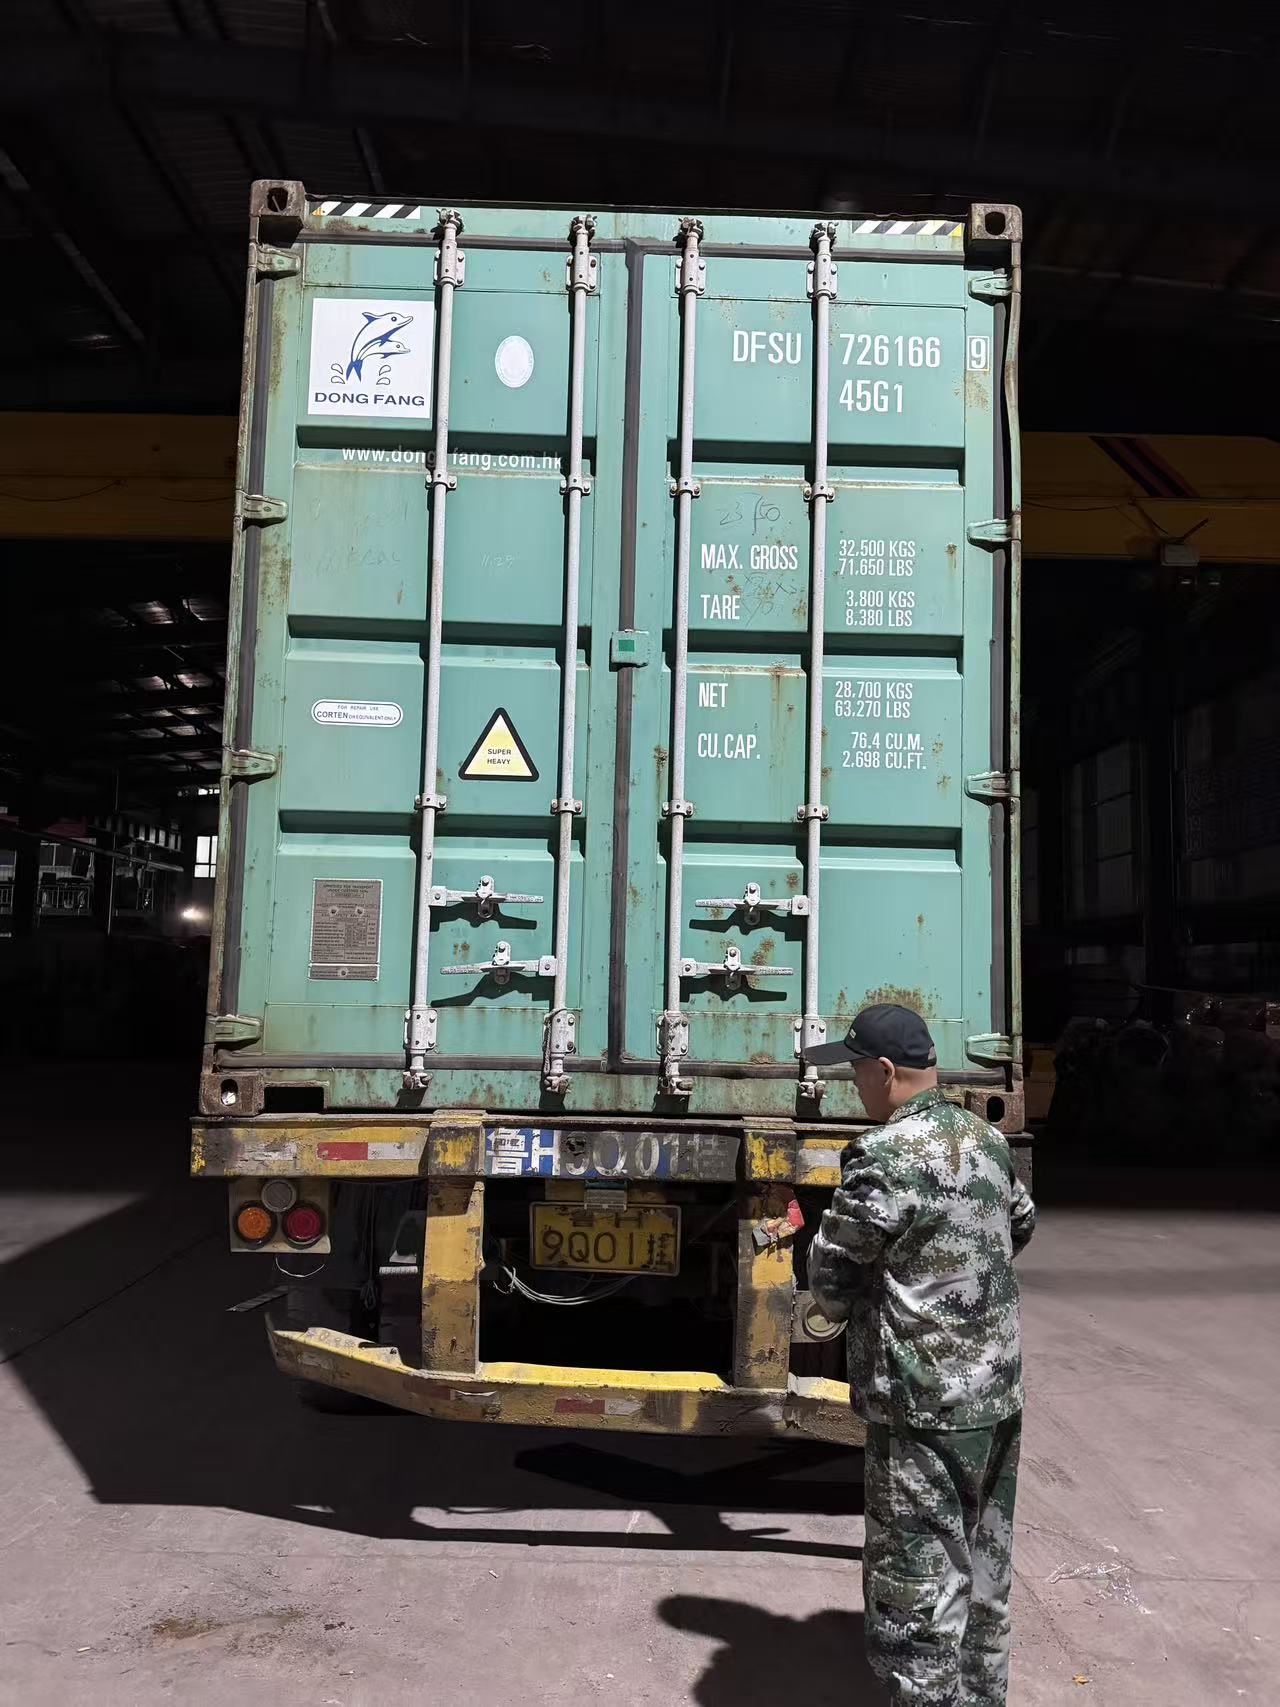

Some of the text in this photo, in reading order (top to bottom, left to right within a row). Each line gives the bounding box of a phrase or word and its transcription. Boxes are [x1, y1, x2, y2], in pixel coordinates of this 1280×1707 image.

[732, 330, 989, 370] DFSU 726166 9
[314, 392, 425, 406] DONG FANG
[839, 379, 904, 413] 45G1
[701, 543, 799, 570] MAX. GROSS
[889, 540, 916, 558] KGS
[888, 559, 914, 577] LBS
[700, 594, 740, 620] TARE
[888, 590, 916, 608] KGS
[888, 609, 913, 627] LBS
[698, 682, 729, 708] NET
[886, 682, 913, 700] KGS
[316, 710, 349, 719] CORTEN
[886, 700, 911, 719] LBS
[850, 731, 925, 751] 76.4 CU.M.
[487, 748, 512, 756] SUPER
[885, 751, 927, 770] CU.FT.
